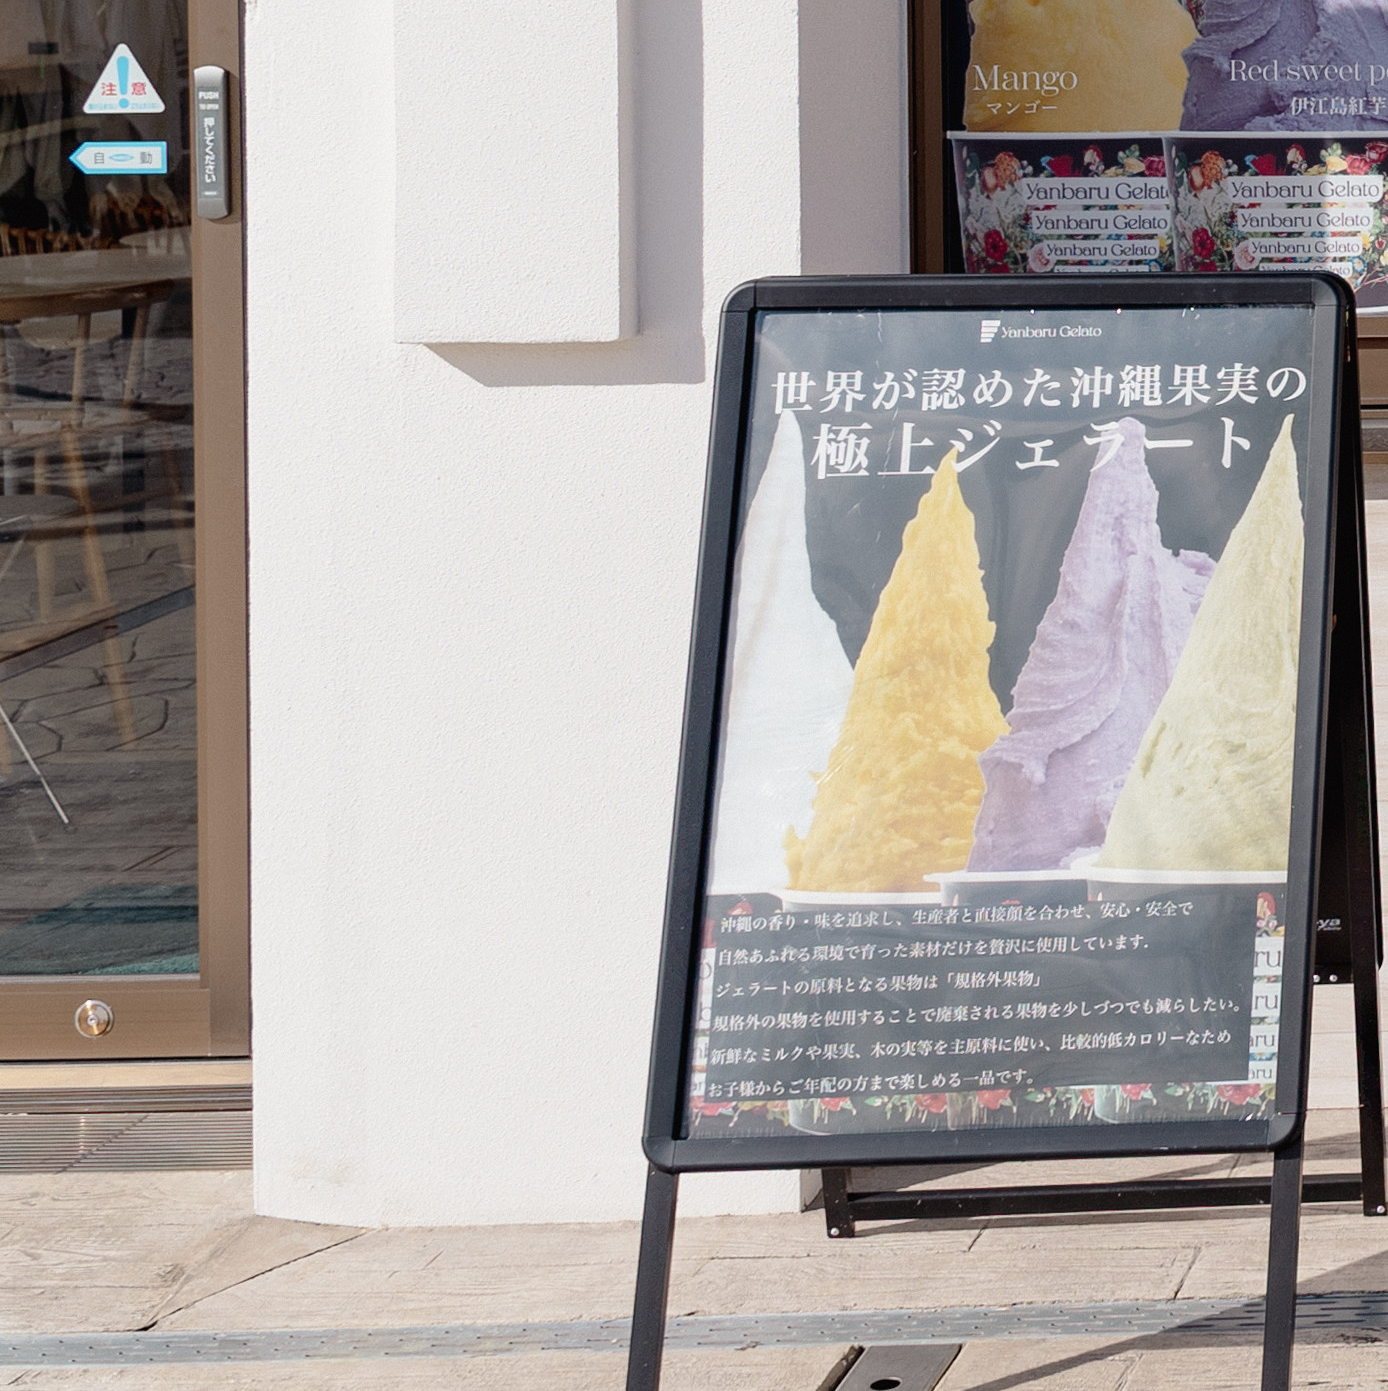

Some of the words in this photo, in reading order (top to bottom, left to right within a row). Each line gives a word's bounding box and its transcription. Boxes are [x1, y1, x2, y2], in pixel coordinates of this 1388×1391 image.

[972, 64, 1078, 96] Mango
[1229, 59, 1279, 83] Red
[1286, 62, 1363, 83] sweet
[987, 100, 1058, 115] マンゴー
[1289, 96, 1387, 117] 伊江島紅芋
[1026, 182, 1110, 202] Yanbaru
[1115, 182, 1169, 201] Gelat
[1231, 181, 1315, 199] Yanbaru
[1318, 180, 1381, 198] Gelato
[1035, 214, 1110, 232] Yanbaru
[1112, 212, 1168, 230] Gelato
[1241, 212, 1315, 229] Yanbaru
[1317, 211, 1371, 228] Gelato
[1046, 243, 1108, 258] Yanbaru
[1111, 242, 1157, 257] Gelato
[1251, 241, 1312, 256] Yanbaru
[1316, 240, 1361, 254] Gelato
[1001, 325, 1056, 339] Yanbaru
[1059, 324, 1102, 338] Gelato
[770, 362, 1308, 415] 世界が認めた沖縄果実の
[810, 415, 1252, 480] 極上ジェラート
